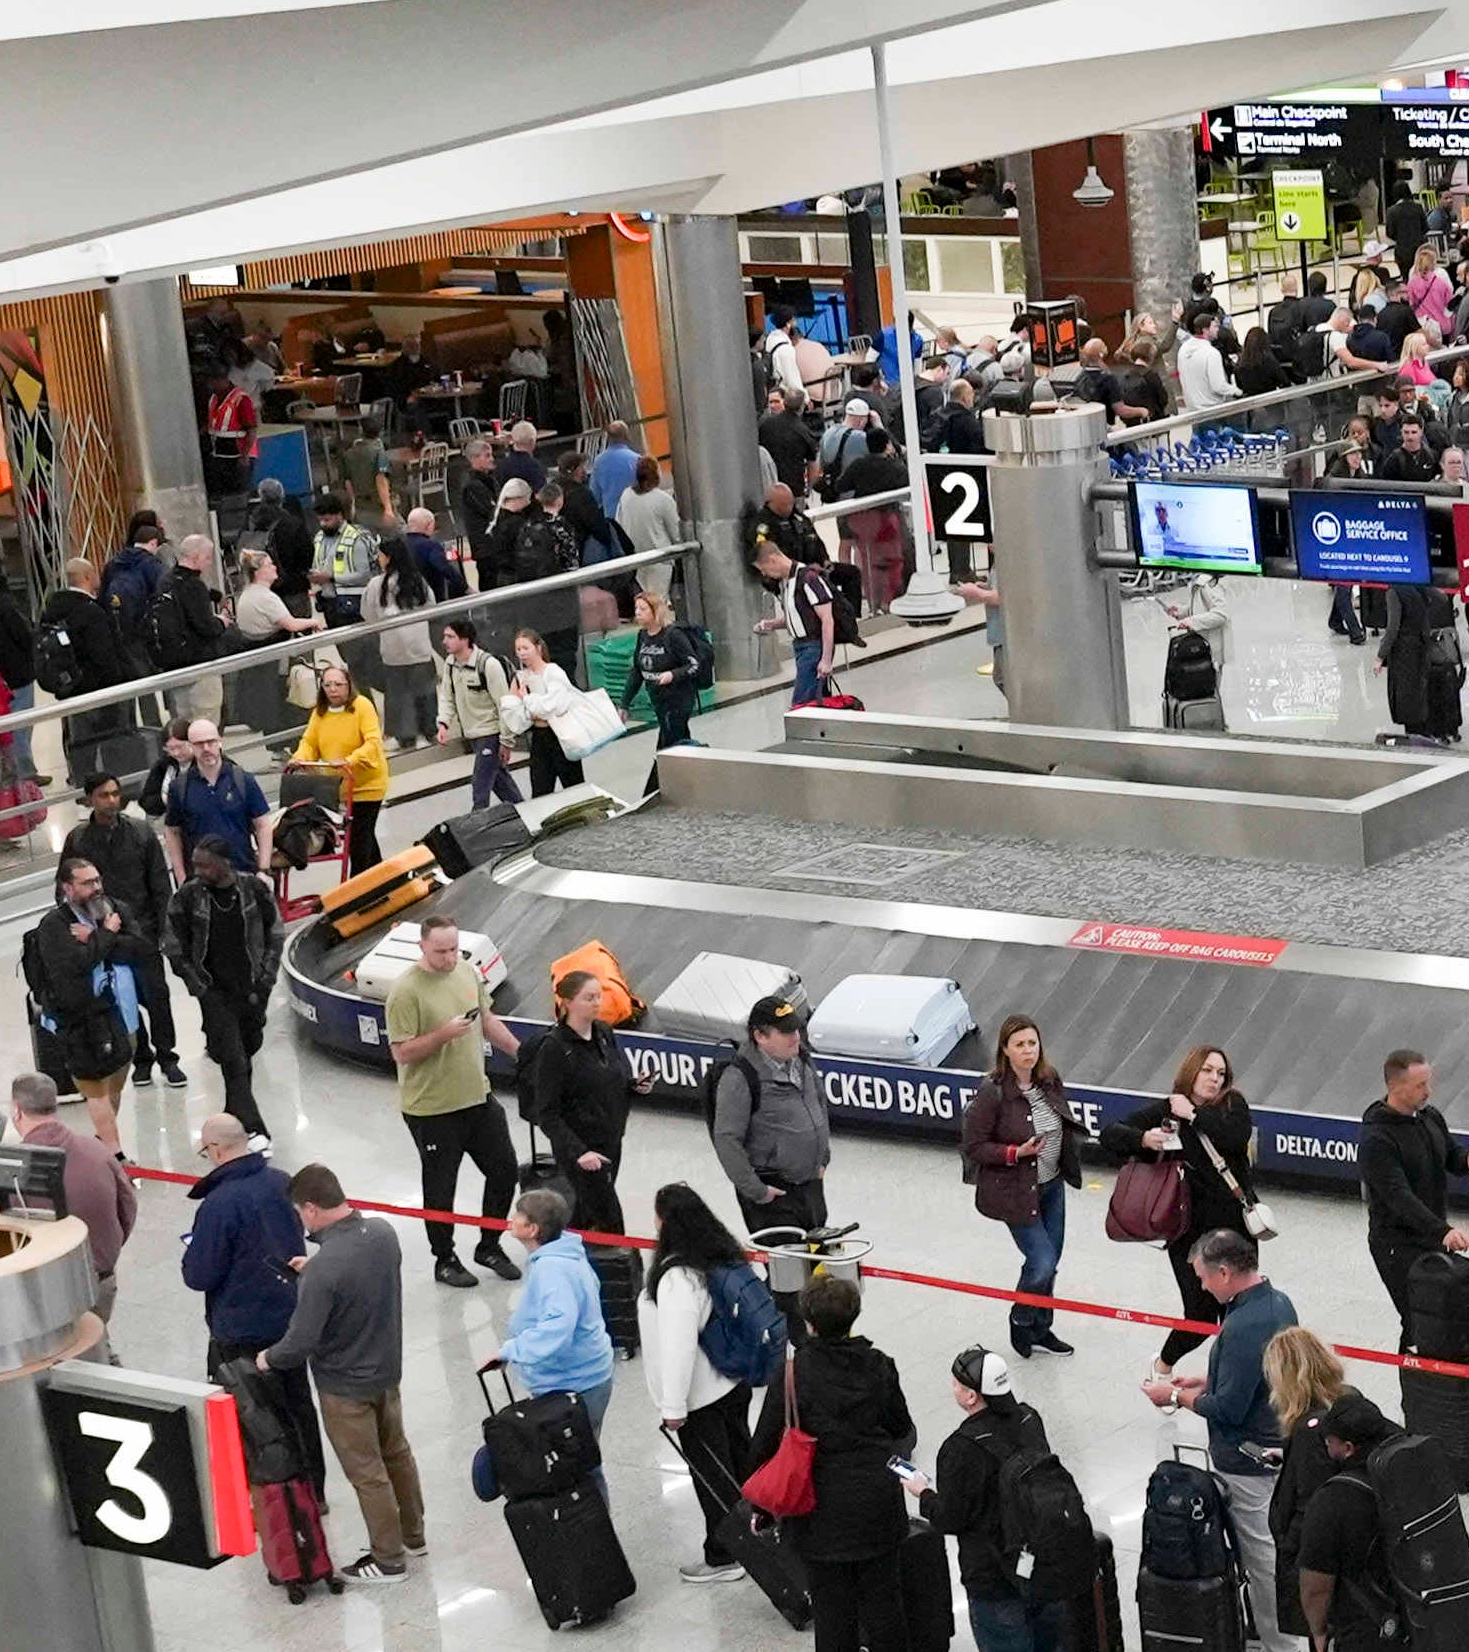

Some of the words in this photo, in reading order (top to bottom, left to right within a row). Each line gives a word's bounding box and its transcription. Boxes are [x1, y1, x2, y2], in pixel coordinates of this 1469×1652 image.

[1252, 105, 1279, 119] Main
[1281, 105, 1348, 121] Checkpoint
[1393, 107, 1448, 122] Ticketing
[1254, 133, 1301, 147] Terminal
[1302, 133, 1343, 147] North
[1408, 134, 1444, 148] South
[1273, 173, 1321, 184] CHECKPOINT
[940, 471, 983, 538] 2
[1385, 501, 1411, 509] DELTA
[1345, 519, 1385, 530] BAGGAGE
[1346, 530, 1379, 540] SERVICE
[1379, 531, 1408, 541] OFFICE
[1319, 552, 1346, 561] LOCATED
[1346, 552, 1363, 561] NEXT
[1111, 928, 1163, 942] CAUTION:
[1105, 936, 1141, 950] PLEASE
[1142, 939, 1170, 951] KEEP
[1169, 942, 1192, 954] OFF
[1190, 945, 1214, 956] BAG
[1213, 947, 1276, 963] CAROUSELS
[624, 1046, 698, 1088] YOUR
[816, 1068, 895, 1111] CKED
[900, 1080, 954, 1119] BAG
[77, 1410, 174, 1545] 3
